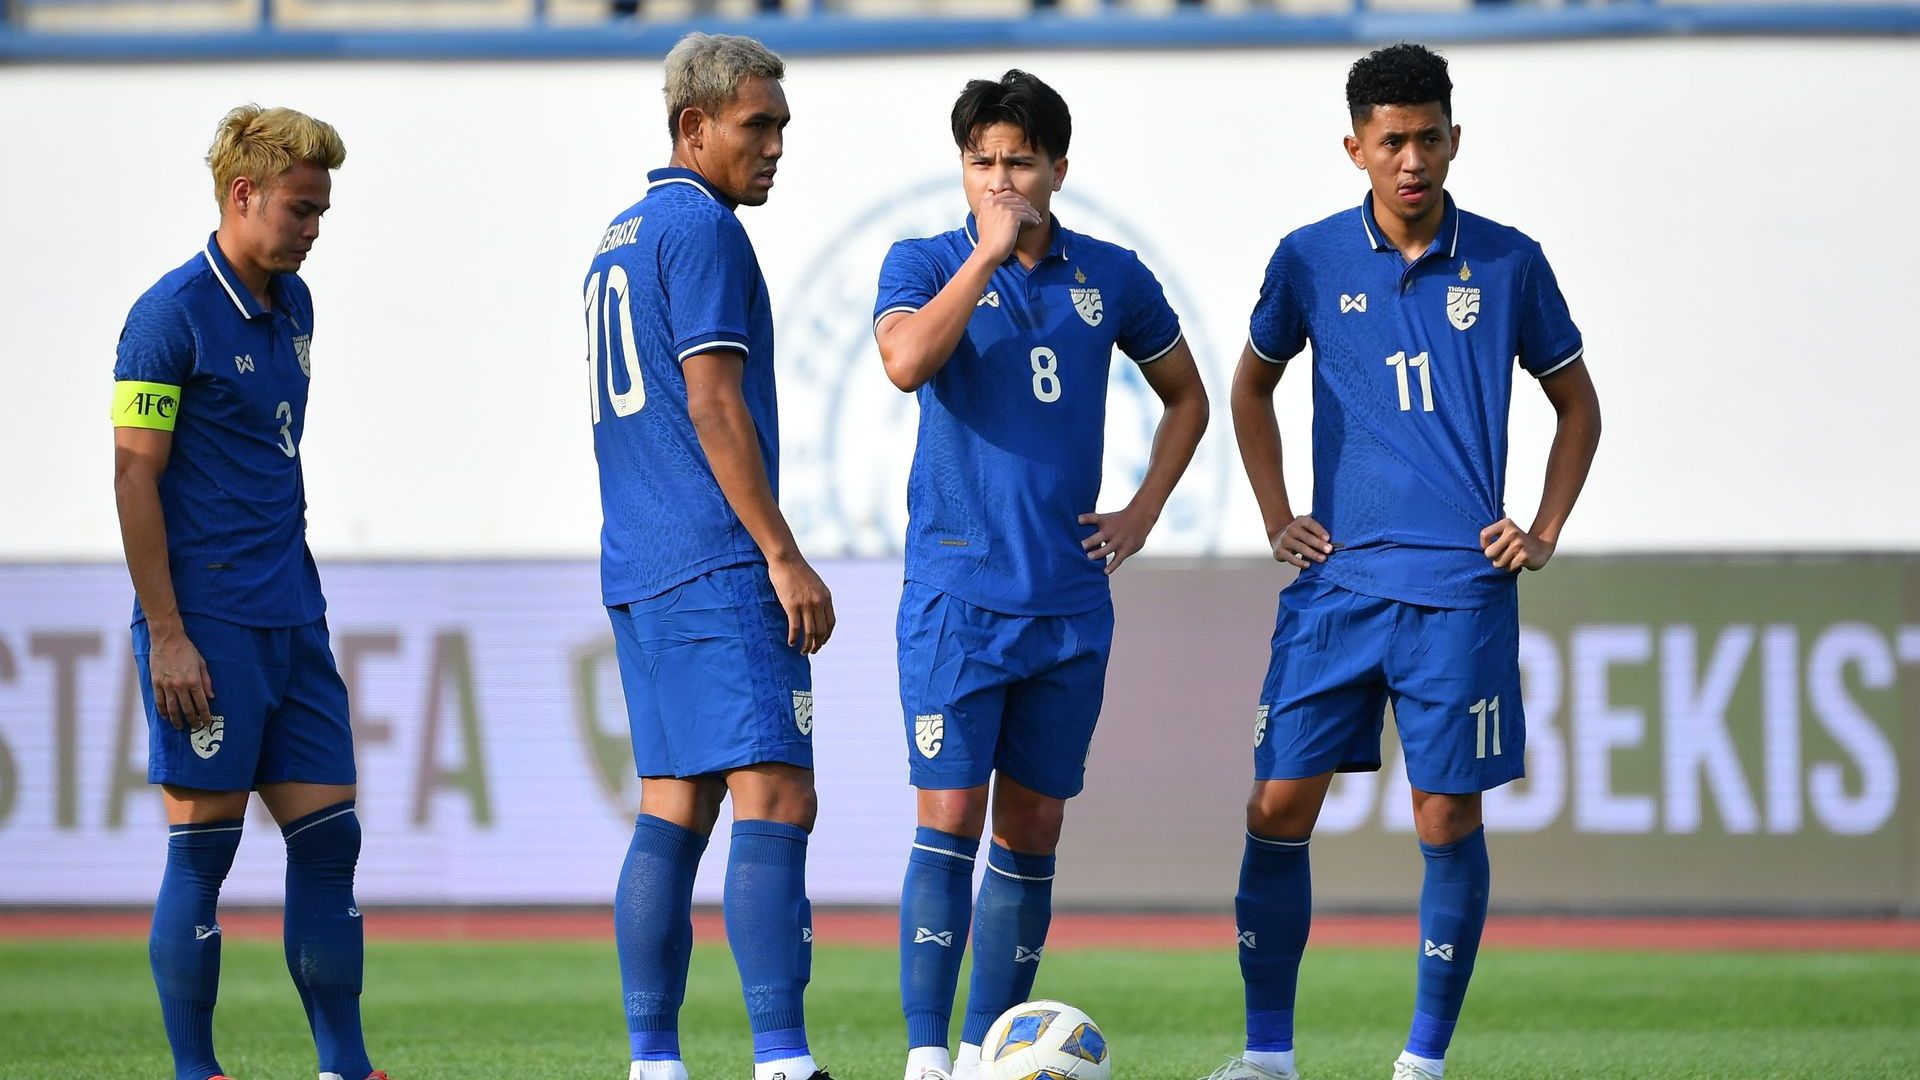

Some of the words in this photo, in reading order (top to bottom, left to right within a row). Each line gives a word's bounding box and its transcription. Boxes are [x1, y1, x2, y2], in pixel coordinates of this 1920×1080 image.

[1447, 286, 1481, 294] THAILAND
[585, 263, 647, 424] 10
[1030, 346, 1061, 403] 8
[1385, 351, 1434, 412] 11
[124, 393, 176, 418] AFC
[275, 400, 296, 458] 3
[1310, 620, 1920, 838] BEKIS
[1469, 695, 1502, 759] 11
